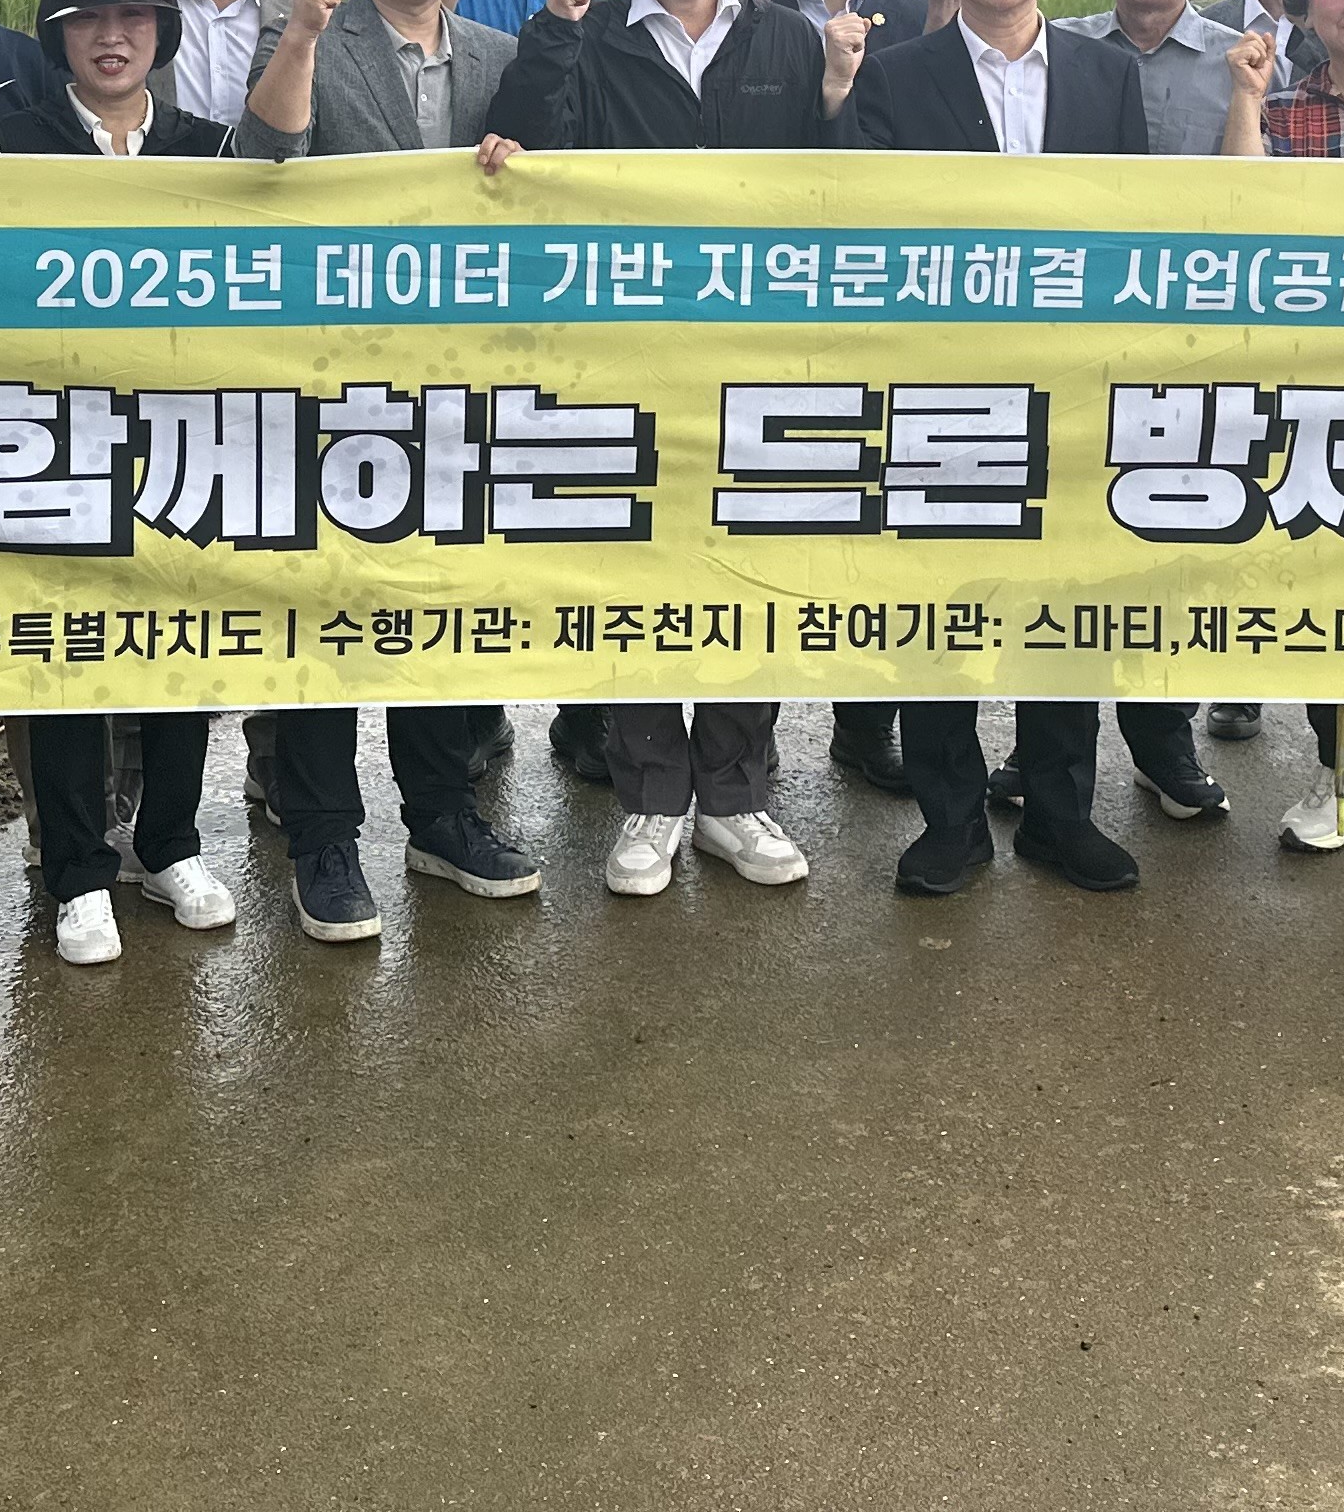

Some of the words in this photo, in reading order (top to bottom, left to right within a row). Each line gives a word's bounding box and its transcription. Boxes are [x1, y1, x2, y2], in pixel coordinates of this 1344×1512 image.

[36, 245, 281, 310] 2025년
[317, 243, 509, 308] 데이터
[544, 243, 672, 305] 기반
[697, 244, 1086, 308] 지역문제해결
[712, 383, 1050, 540] 드론
[320, 607, 530, 655] 수행기관:
[554, 603, 741, 652] 제주천지
[798, 602, 1001, 651] 참여기관:
